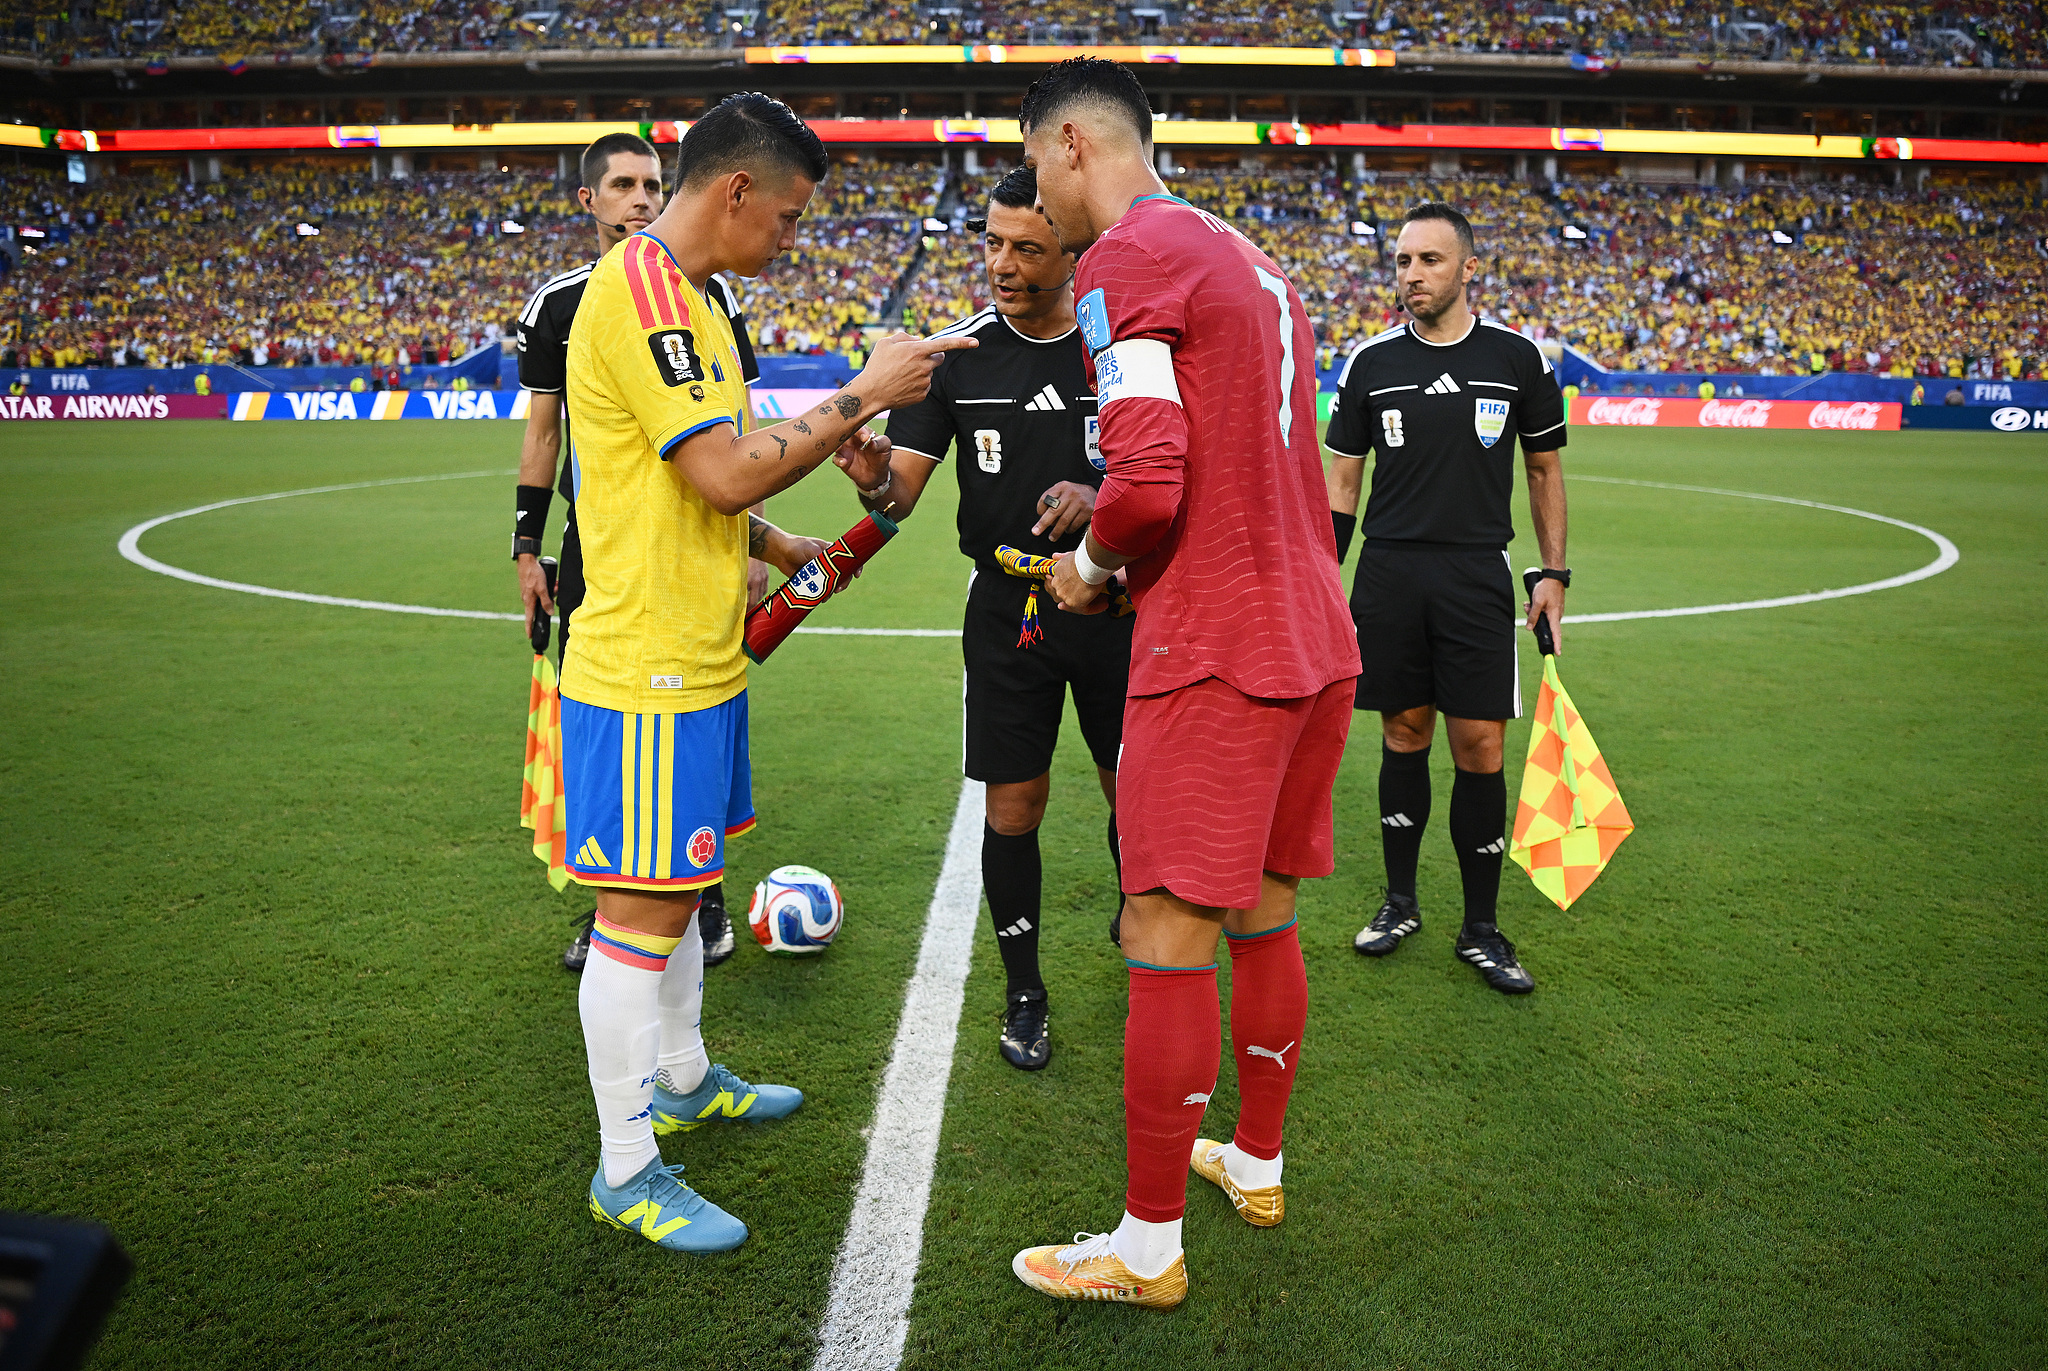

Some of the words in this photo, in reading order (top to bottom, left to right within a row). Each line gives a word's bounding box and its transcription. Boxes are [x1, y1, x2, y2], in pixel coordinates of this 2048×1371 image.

[1254, 265, 1295, 449] 7
[51, 374, 90, 390] FIFA
[1974, 384, 2012, 401] FIFA
[63, 395, 169, 419] AIRWAYS
[284, 392, 357, 420] VISA
[422, 391, 497, 419] VISA
[1480, 403, 1506, 415] FIFA
